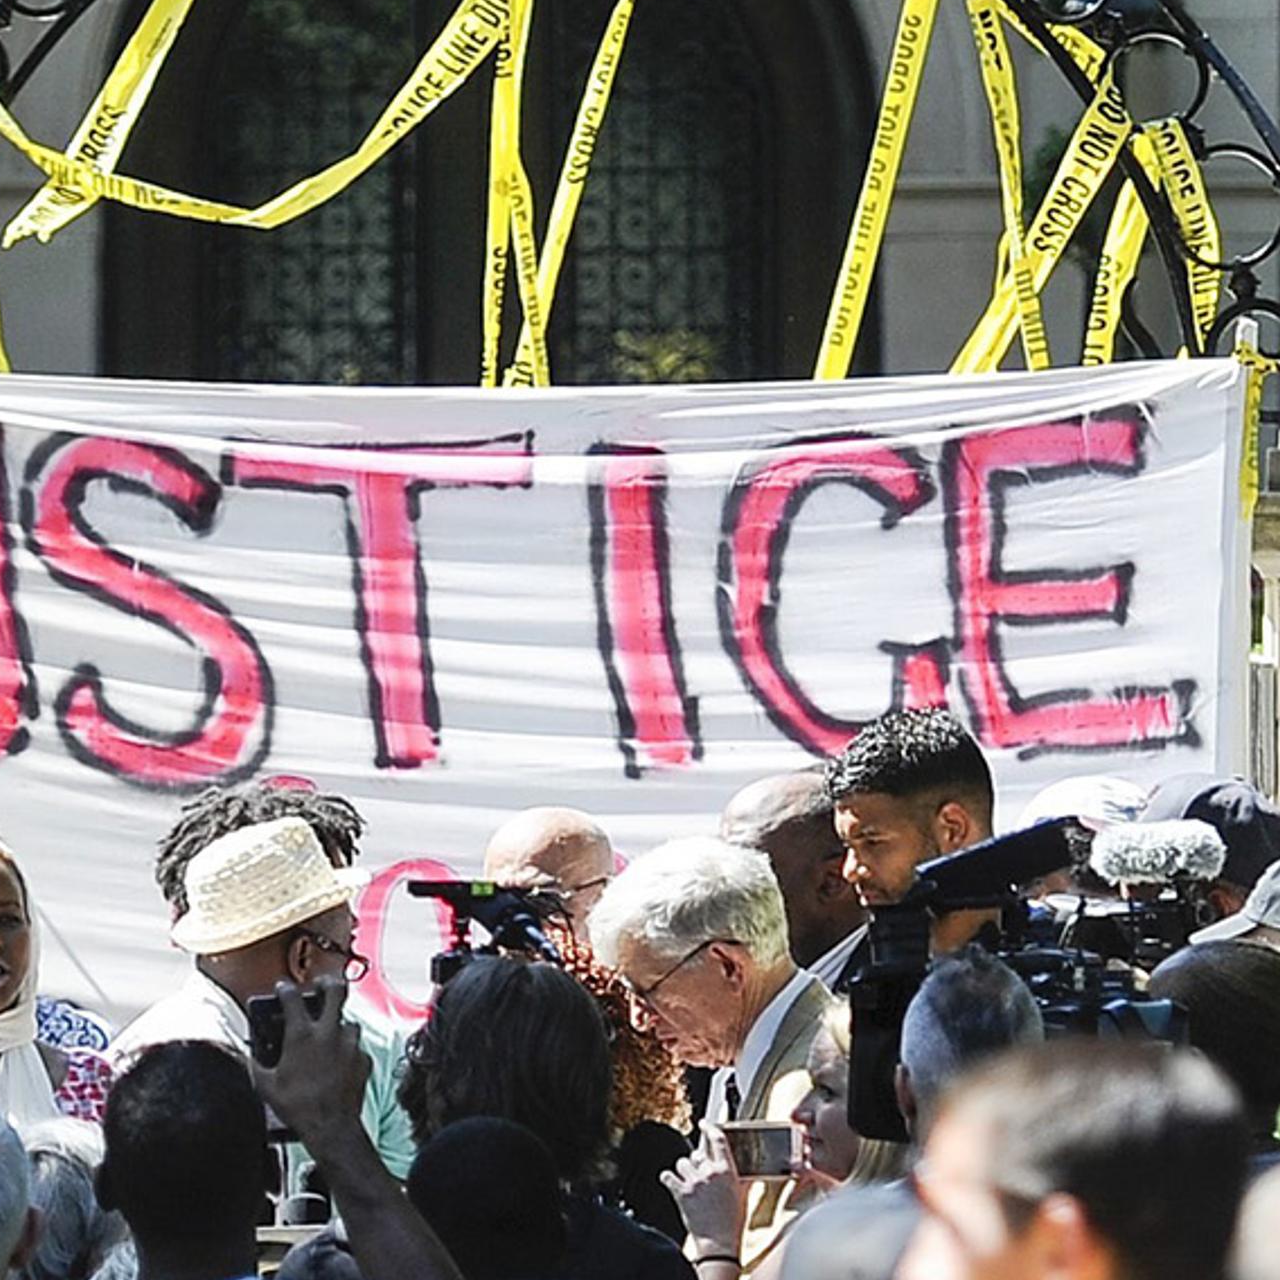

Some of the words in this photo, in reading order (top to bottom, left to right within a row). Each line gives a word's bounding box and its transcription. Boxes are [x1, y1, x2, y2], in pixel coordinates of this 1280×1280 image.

[435, 23, 489, 76] LINE
[75, 104, 126, 170] ROSS
[1073, 122, 1120, 176] NOT
[1034, 175, 1091, 255] CROSS
